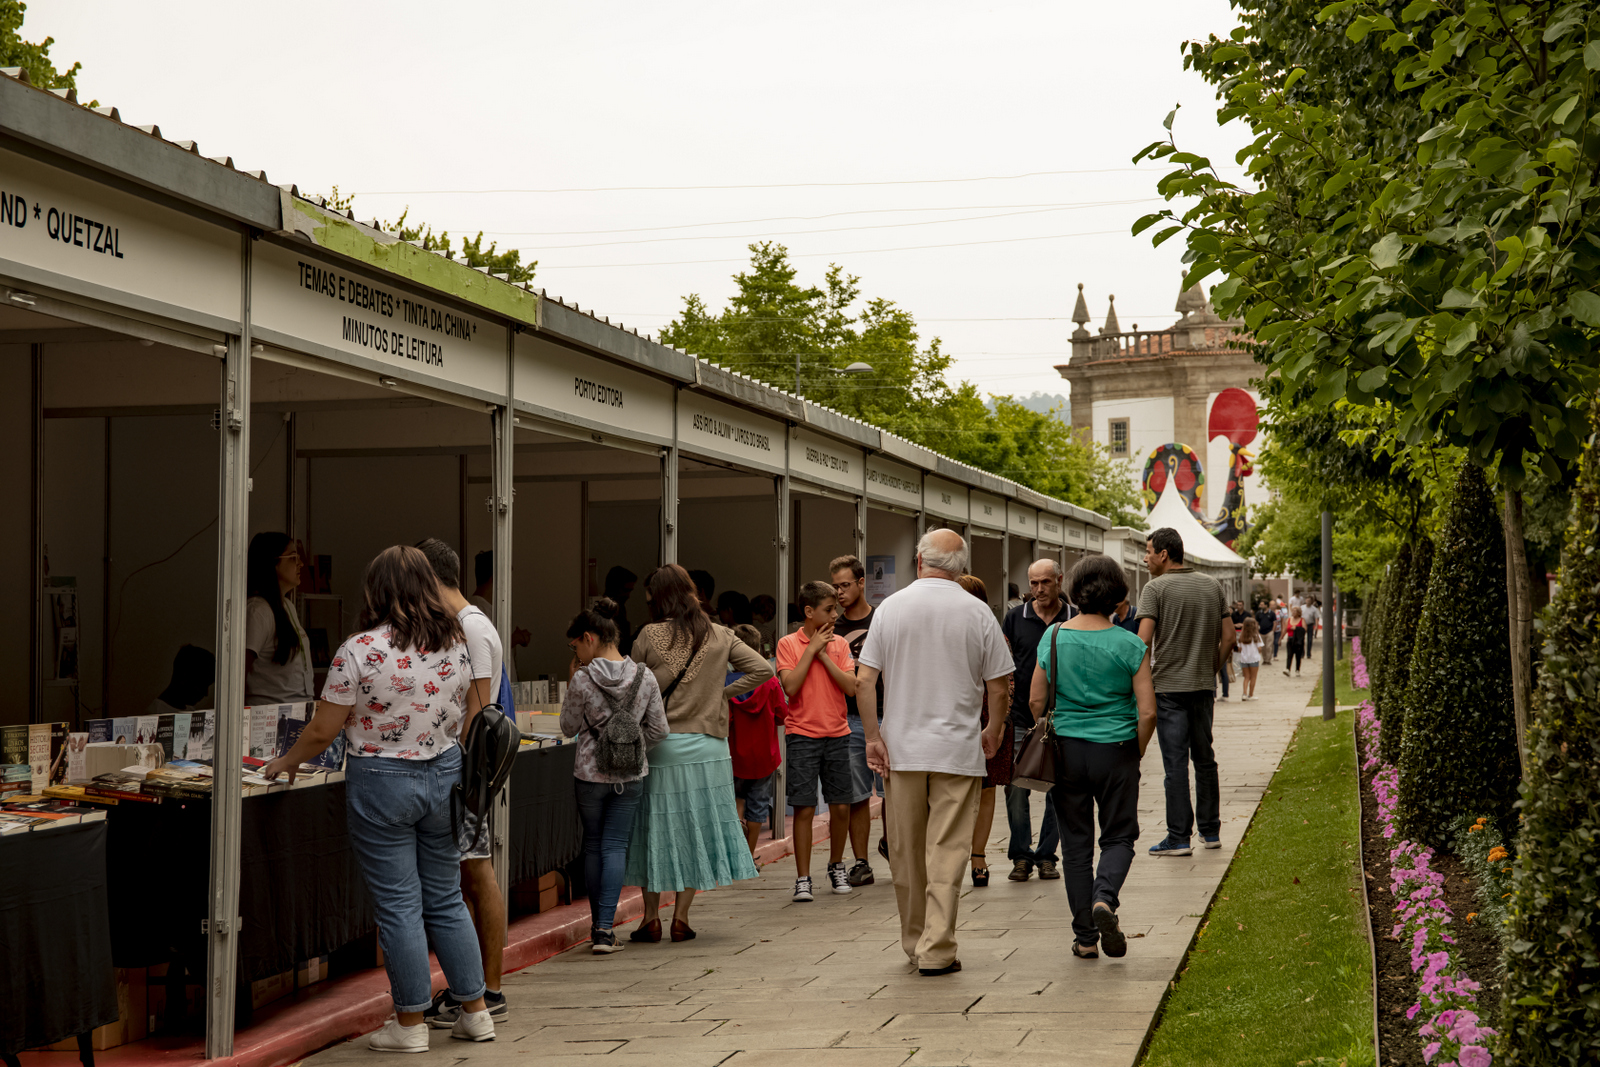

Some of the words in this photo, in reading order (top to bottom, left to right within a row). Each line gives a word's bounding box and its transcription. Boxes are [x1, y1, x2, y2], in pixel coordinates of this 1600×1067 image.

[0, 191, 27, 228] ND
[47, 207, 124, 259] QUETZAL
[298, 261, 336, 298] TEMAS
[339, 276, 345, 301] E
[348, 280, 394, 318] DEBATES
[403, 299, 429, 329] TINTA
[431, 308, 443, 333] DA
[445, 313, 472, 341] CHINA
[343, 316, 388, 353] MINUTOS
[391, 332, 404, 357] DE
[406, 336, 444, 368] LEITURA
[575, 377, 597, 402] PORTO
[598, 385, 624, 409] EDITORA
[713, 420, 717, 435] &
[734, 427, 749, 445] LIVROS
[757, 434, 770, 451] BRASIL
[114, 725, 134, 735] WOOLF
[29, 744, 50, 754] SECRETA
